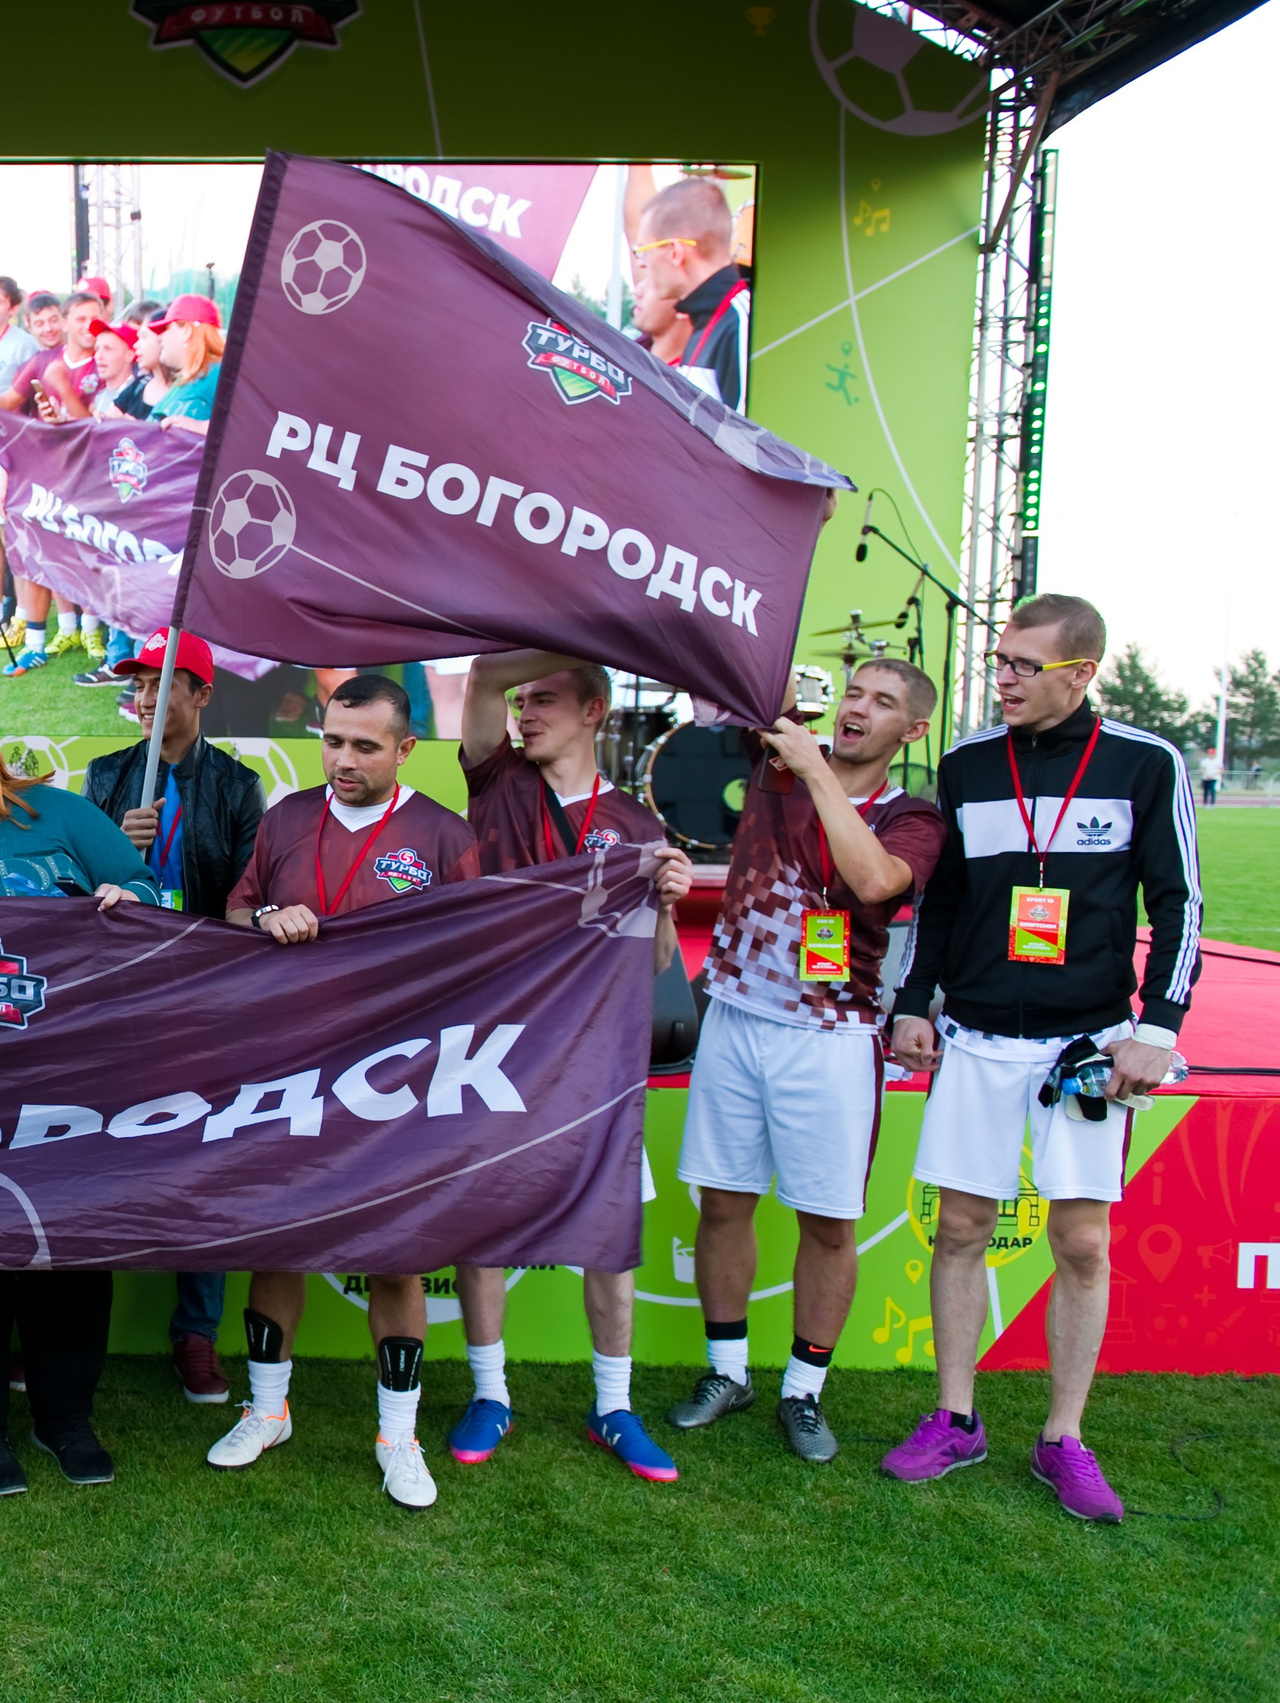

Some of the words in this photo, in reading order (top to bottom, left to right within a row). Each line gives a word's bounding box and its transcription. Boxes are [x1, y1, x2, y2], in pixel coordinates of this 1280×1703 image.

[191, 6, 304, 22] ФУТБОЛ
[536, 328, 625, 384] ТУРБО
[265, 410, 362, 492] РЦ
[376, 444, 763, 637] БОГОРОДСК
[1077, 838, 1111, 846] adidas
[380, 860, 428, 880] ТУРБО
